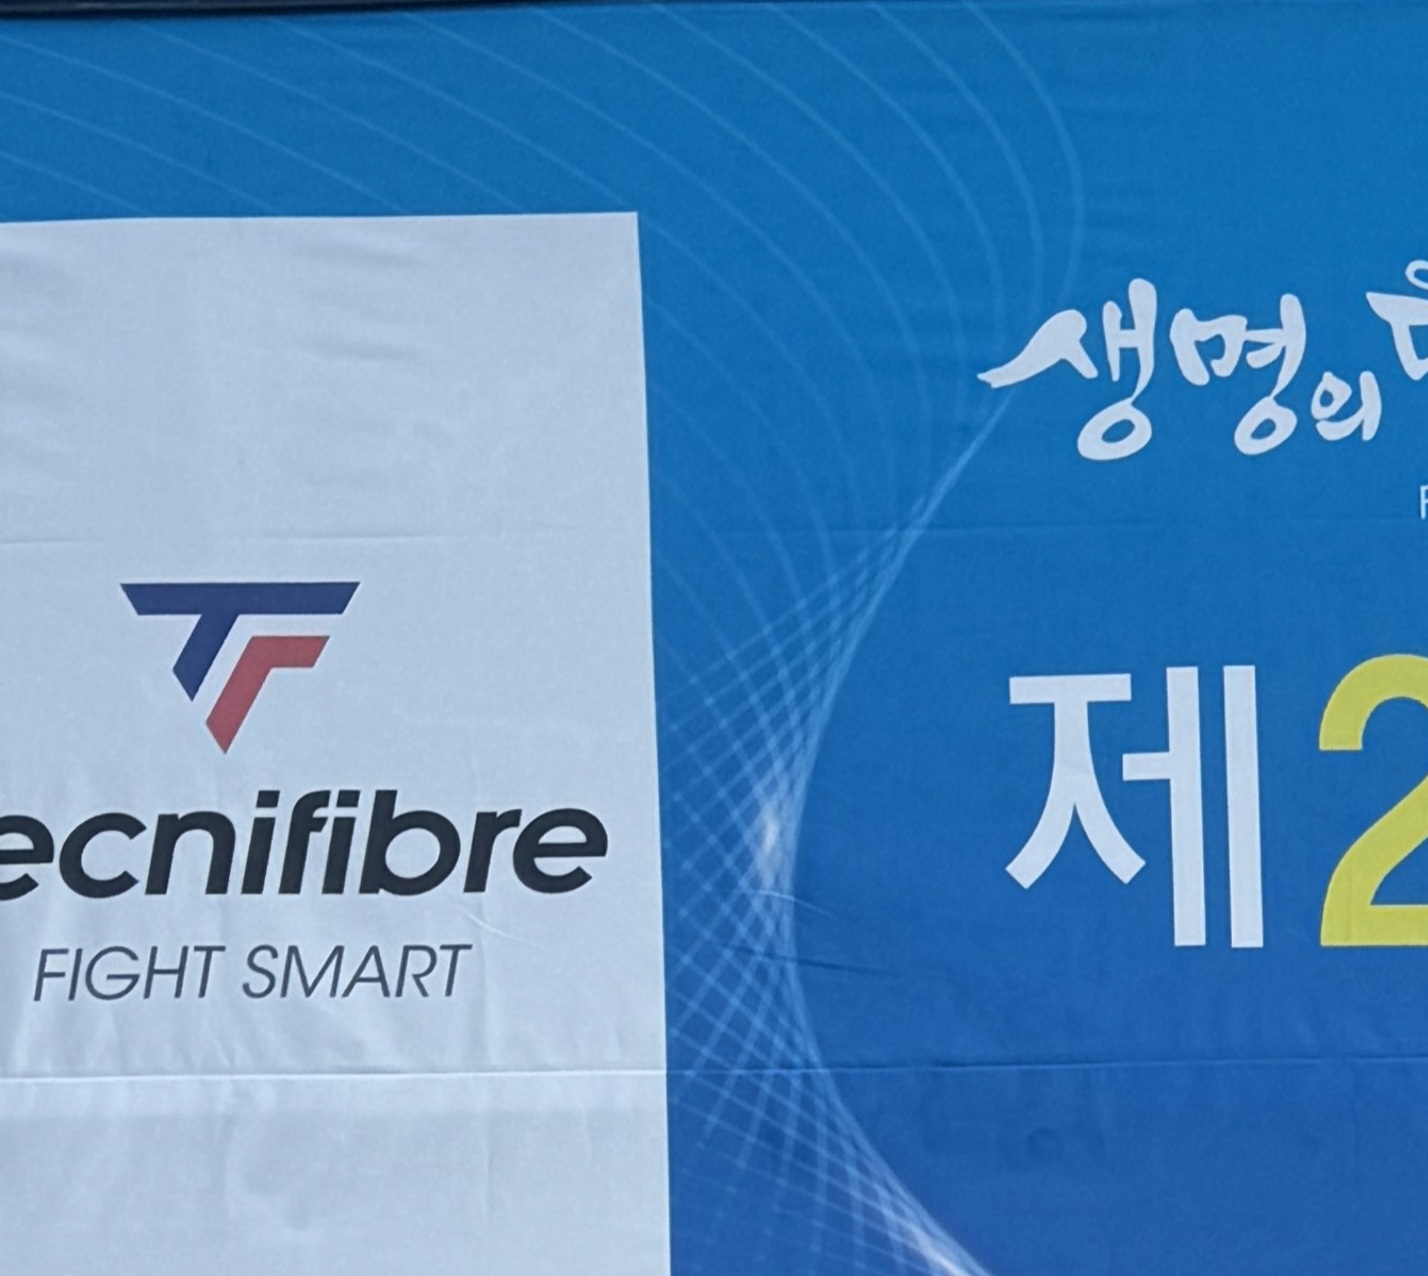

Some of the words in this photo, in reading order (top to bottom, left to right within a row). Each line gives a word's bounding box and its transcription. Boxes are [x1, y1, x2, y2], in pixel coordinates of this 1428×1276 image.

[977, 278, 1382, 461] 생명의
[33, 945, 226, 1001] FIGHT
[242, 943, 473, 999] SMART
